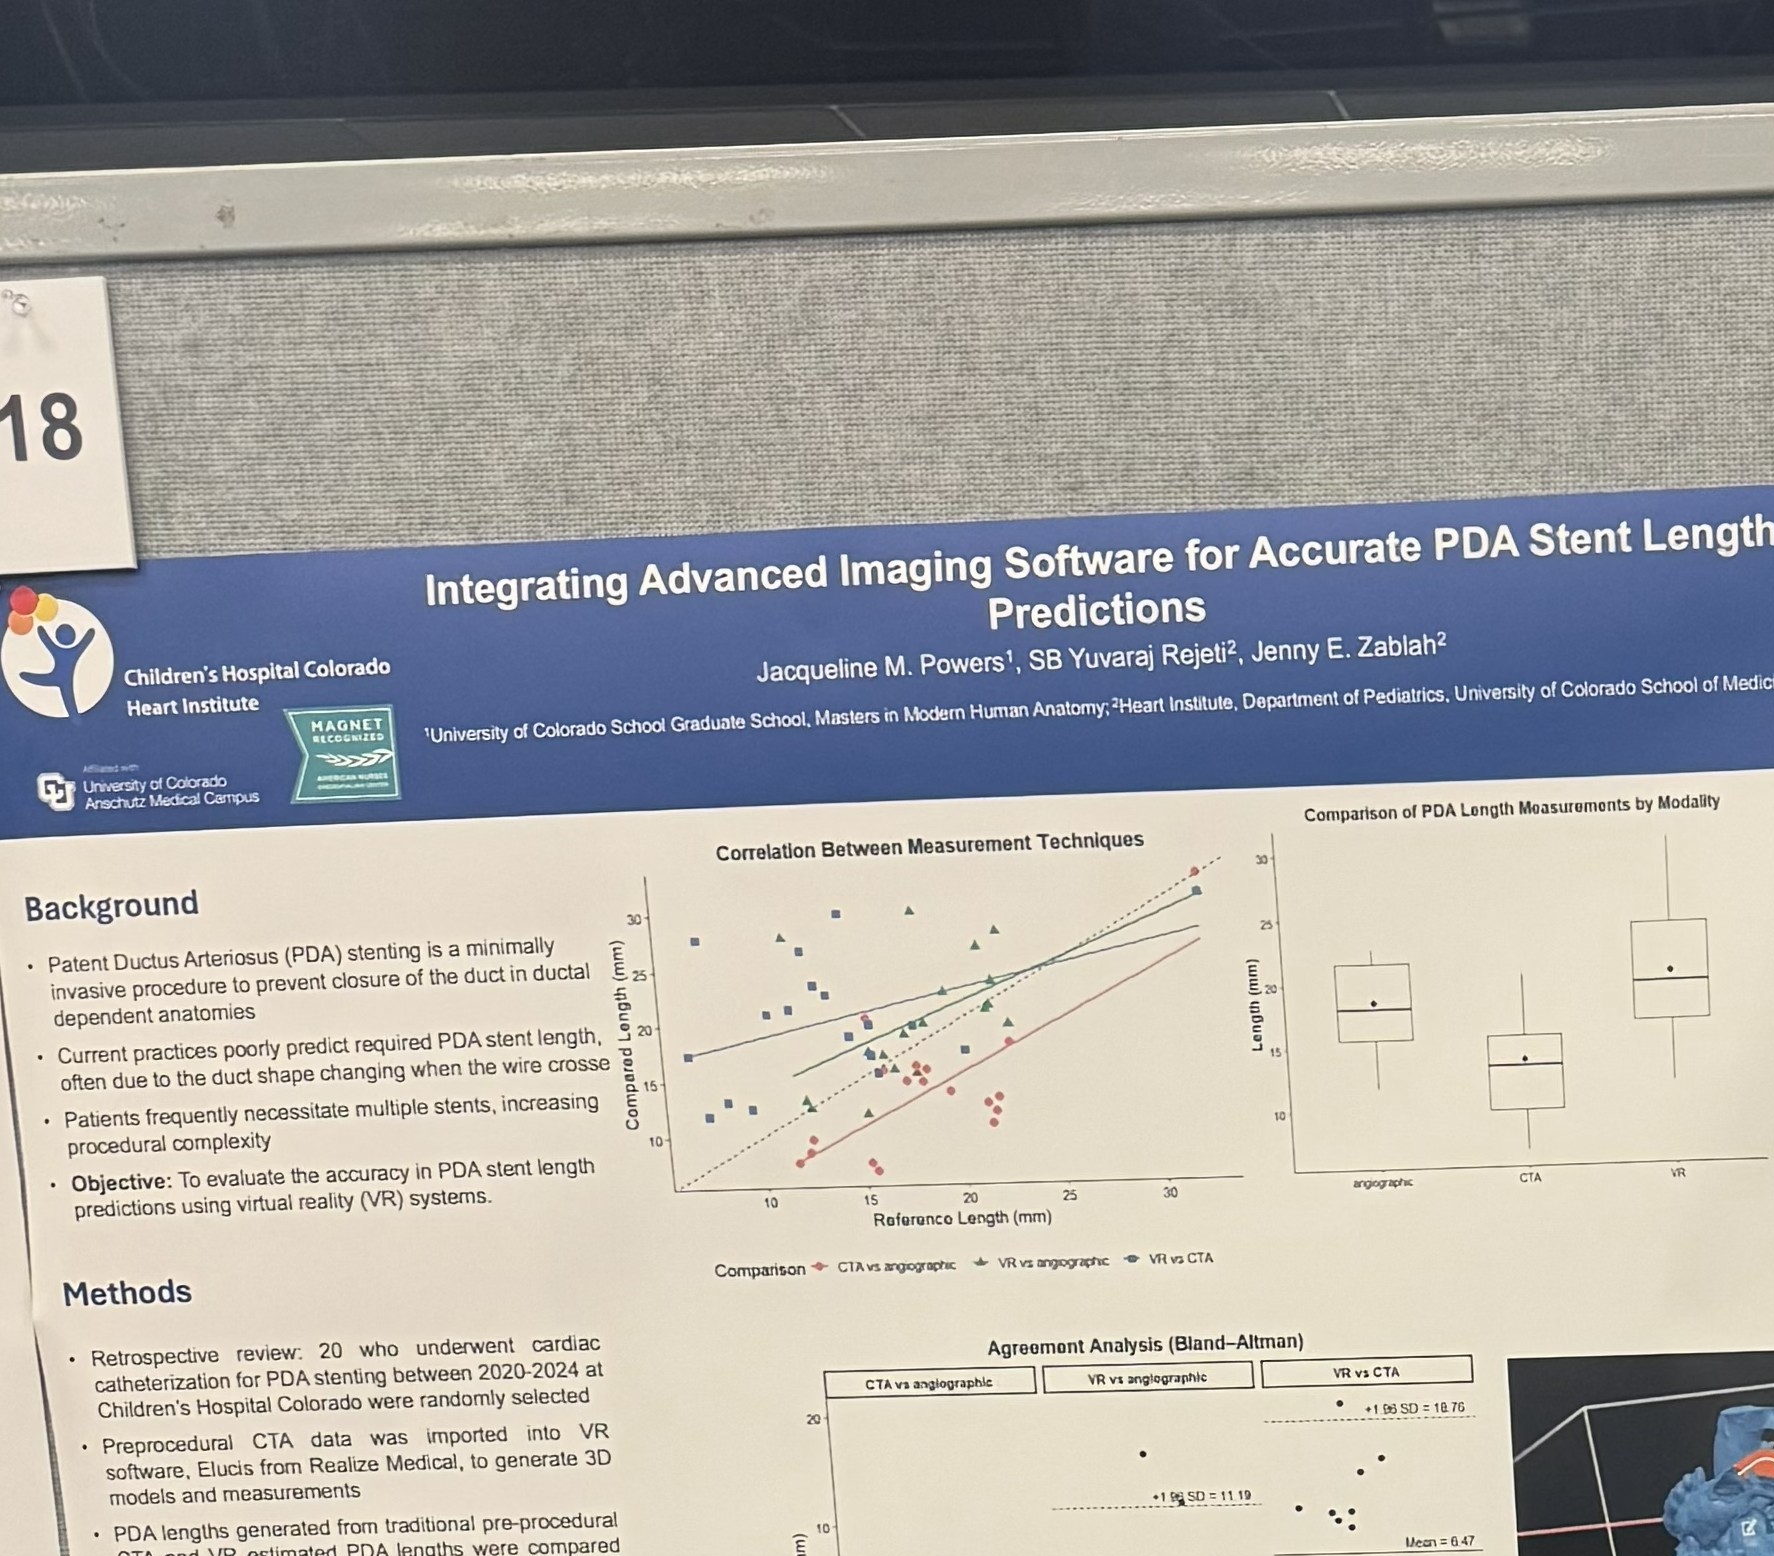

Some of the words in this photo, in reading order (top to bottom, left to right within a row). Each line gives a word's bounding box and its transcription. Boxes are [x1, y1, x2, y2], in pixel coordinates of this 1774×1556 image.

[0, 392, 83, 461] 18
[426, 567, 628, 611] Integrating
[638, 554, 828, 596] Advanced
[840, 549, 992, 592] Imaging
[1004, 543, 1174, 579] Software
[1184, 537, 1241, 572] for
[1248, 530, 1422, 569] Accurate
[1434, 524, 1521, 561] PDA
[1529, 520, 1633, 557] Stent
[988, 591, 1207, 631] Predictions
[124, 665, 219, 687] Children's
[221, 660, 300, 685] Hospital
[303, 656, 391, 678] Colorado
[756, 657, 878, 686] Jacqueline
[884, 654, 913, 677] M.
[1029, 648, 1063, 671] SB
[1068, 644, 1154, 672] Yuvaraj
[1251, 640, 1320, 666] Jenny
[1327, 636, 1351, 659] E.
[126, 699, 179, 717] Heart
[181, 695, 260, 714] Institute
[310, 717, 383, 733] MAGNET
[82, 779, 147, 794] University
[149, 777, 163, 791] of
[165, 774, 228, 790] Colorado
[84, 796, 147, 810] Anschutz
[148, 792, 201, 807] Medical
[203, 791, 261, 806] Campus
[1304, 806, 1398, 824] Comparison
[1402, 804, 1418, 819] of
[1421, 802, 1457, 819] PDA
[1460, 801, 1515, 820] Length
[1518, 798, 1631, 815] Measurements
[1635, 796, 1654, 814] by
[1658, 793, 1721, 811] Modality
[715, 842, 816, 862] Correlation
[821, 841, 903, 858] Between
[907, 835, 1033, 855] Measurement
[1035, 831, 1145, 852] Techniques
[24, 888, 199, 925] Background
[48, 955, 110, 974] Patent
[113, 953, 180, 971] Ductus
[183, 950, 279, 968] Arteriosus
[284, 944, 343, 969] (PDA)
[347, 943, 421, 964] stenting
[427, 940, 443, 958] is
[448, 944, 461, 958] a
[466, 936, 555, 959] minimally
[50, 981, 127, 1001] invasive
[132, 978, 227, 1002] procedure
[232, 976, 251, 994] to
[255, 973, 327, 997] prevent
[331, 971, 401, 990] closure
[405, 968, 424, 987] of
[429, 968, 459, 986] the
[463, 966, 507, 984] duct
[510, 968, 528, 983] in
[532, 961, 591, 982] ductal
[1519, 1171, 1543, 1183] CTA
[1670, 1167, 1687, 1178] VR
[873, 1211, 954, 1227] Reference
[957, 1210, 1010, 1228] Length
[1013, 1209, 1052, 1227] (mm)
[62, 1278, 193, 1307] Methods
[91, 1348, 220, 1369] Retrospective
[236, 1344, 303, 1362] review:
[318, 1341, 343, 1360] 20
[358, 1340, 399, 1358] who
[416, 1337, 516, 1356] underwent
[531, 1334, 601, 1353] cardiac
[94, 1372, 231, 1394] catheterization
[235, 1371, 262, 1388] for
[266, 1369, 311, 1388] PDA
[313, 1367, 387, 1389] stenting
[392, 1366, 473, 1384] between
[477, 1360, 579, 1381] 2020-2024
[585, 1361, 604, 1378] at
[97, 1399, 191, 1419] Children's
[196, 1396, 272, 1418] Hospital
[277, 1393, 363, 1413] Colorado
[367, 1395, 414, 1410] were
[419, 1389, 506, 1410] randomly
[511, 1386, 591, 1406] selected
